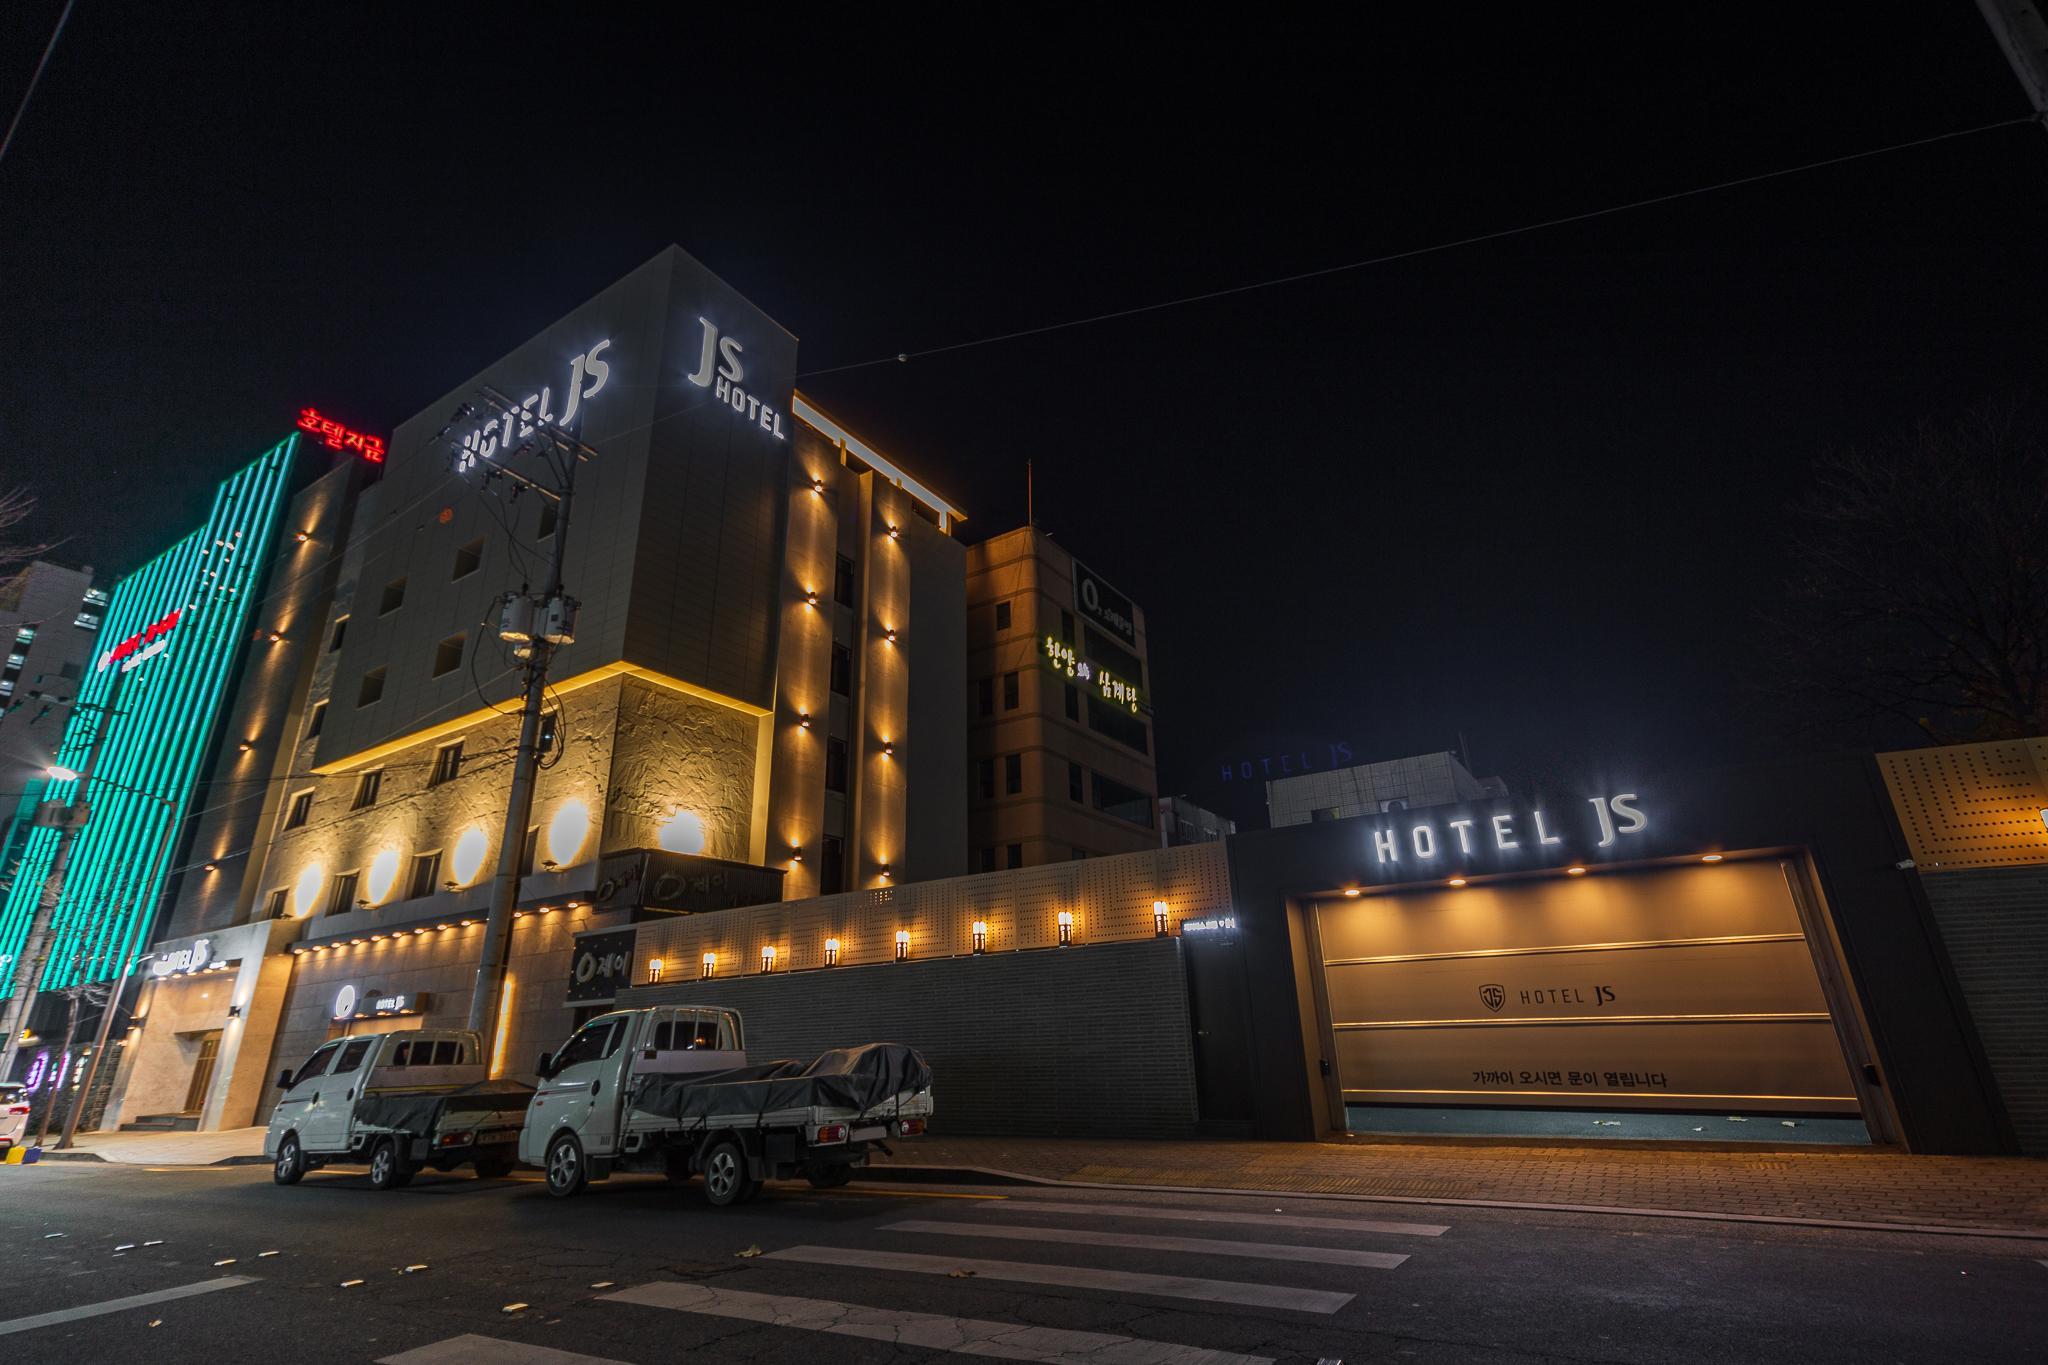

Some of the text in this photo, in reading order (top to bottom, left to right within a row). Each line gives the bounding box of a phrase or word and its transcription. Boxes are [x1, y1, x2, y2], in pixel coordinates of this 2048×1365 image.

[688, 316, 744, 387] JS
[458, 339, 610, 472] HOTEL JS
[716, 375, 784, 440] HOTEL
[1374, 793, 1648, 863] HOTEL JS
[1520, 986, 1616, 1006] HOTEL JS
[1472, 1071, 1668, 1088] 가까이 오시면 문이 열립니다
